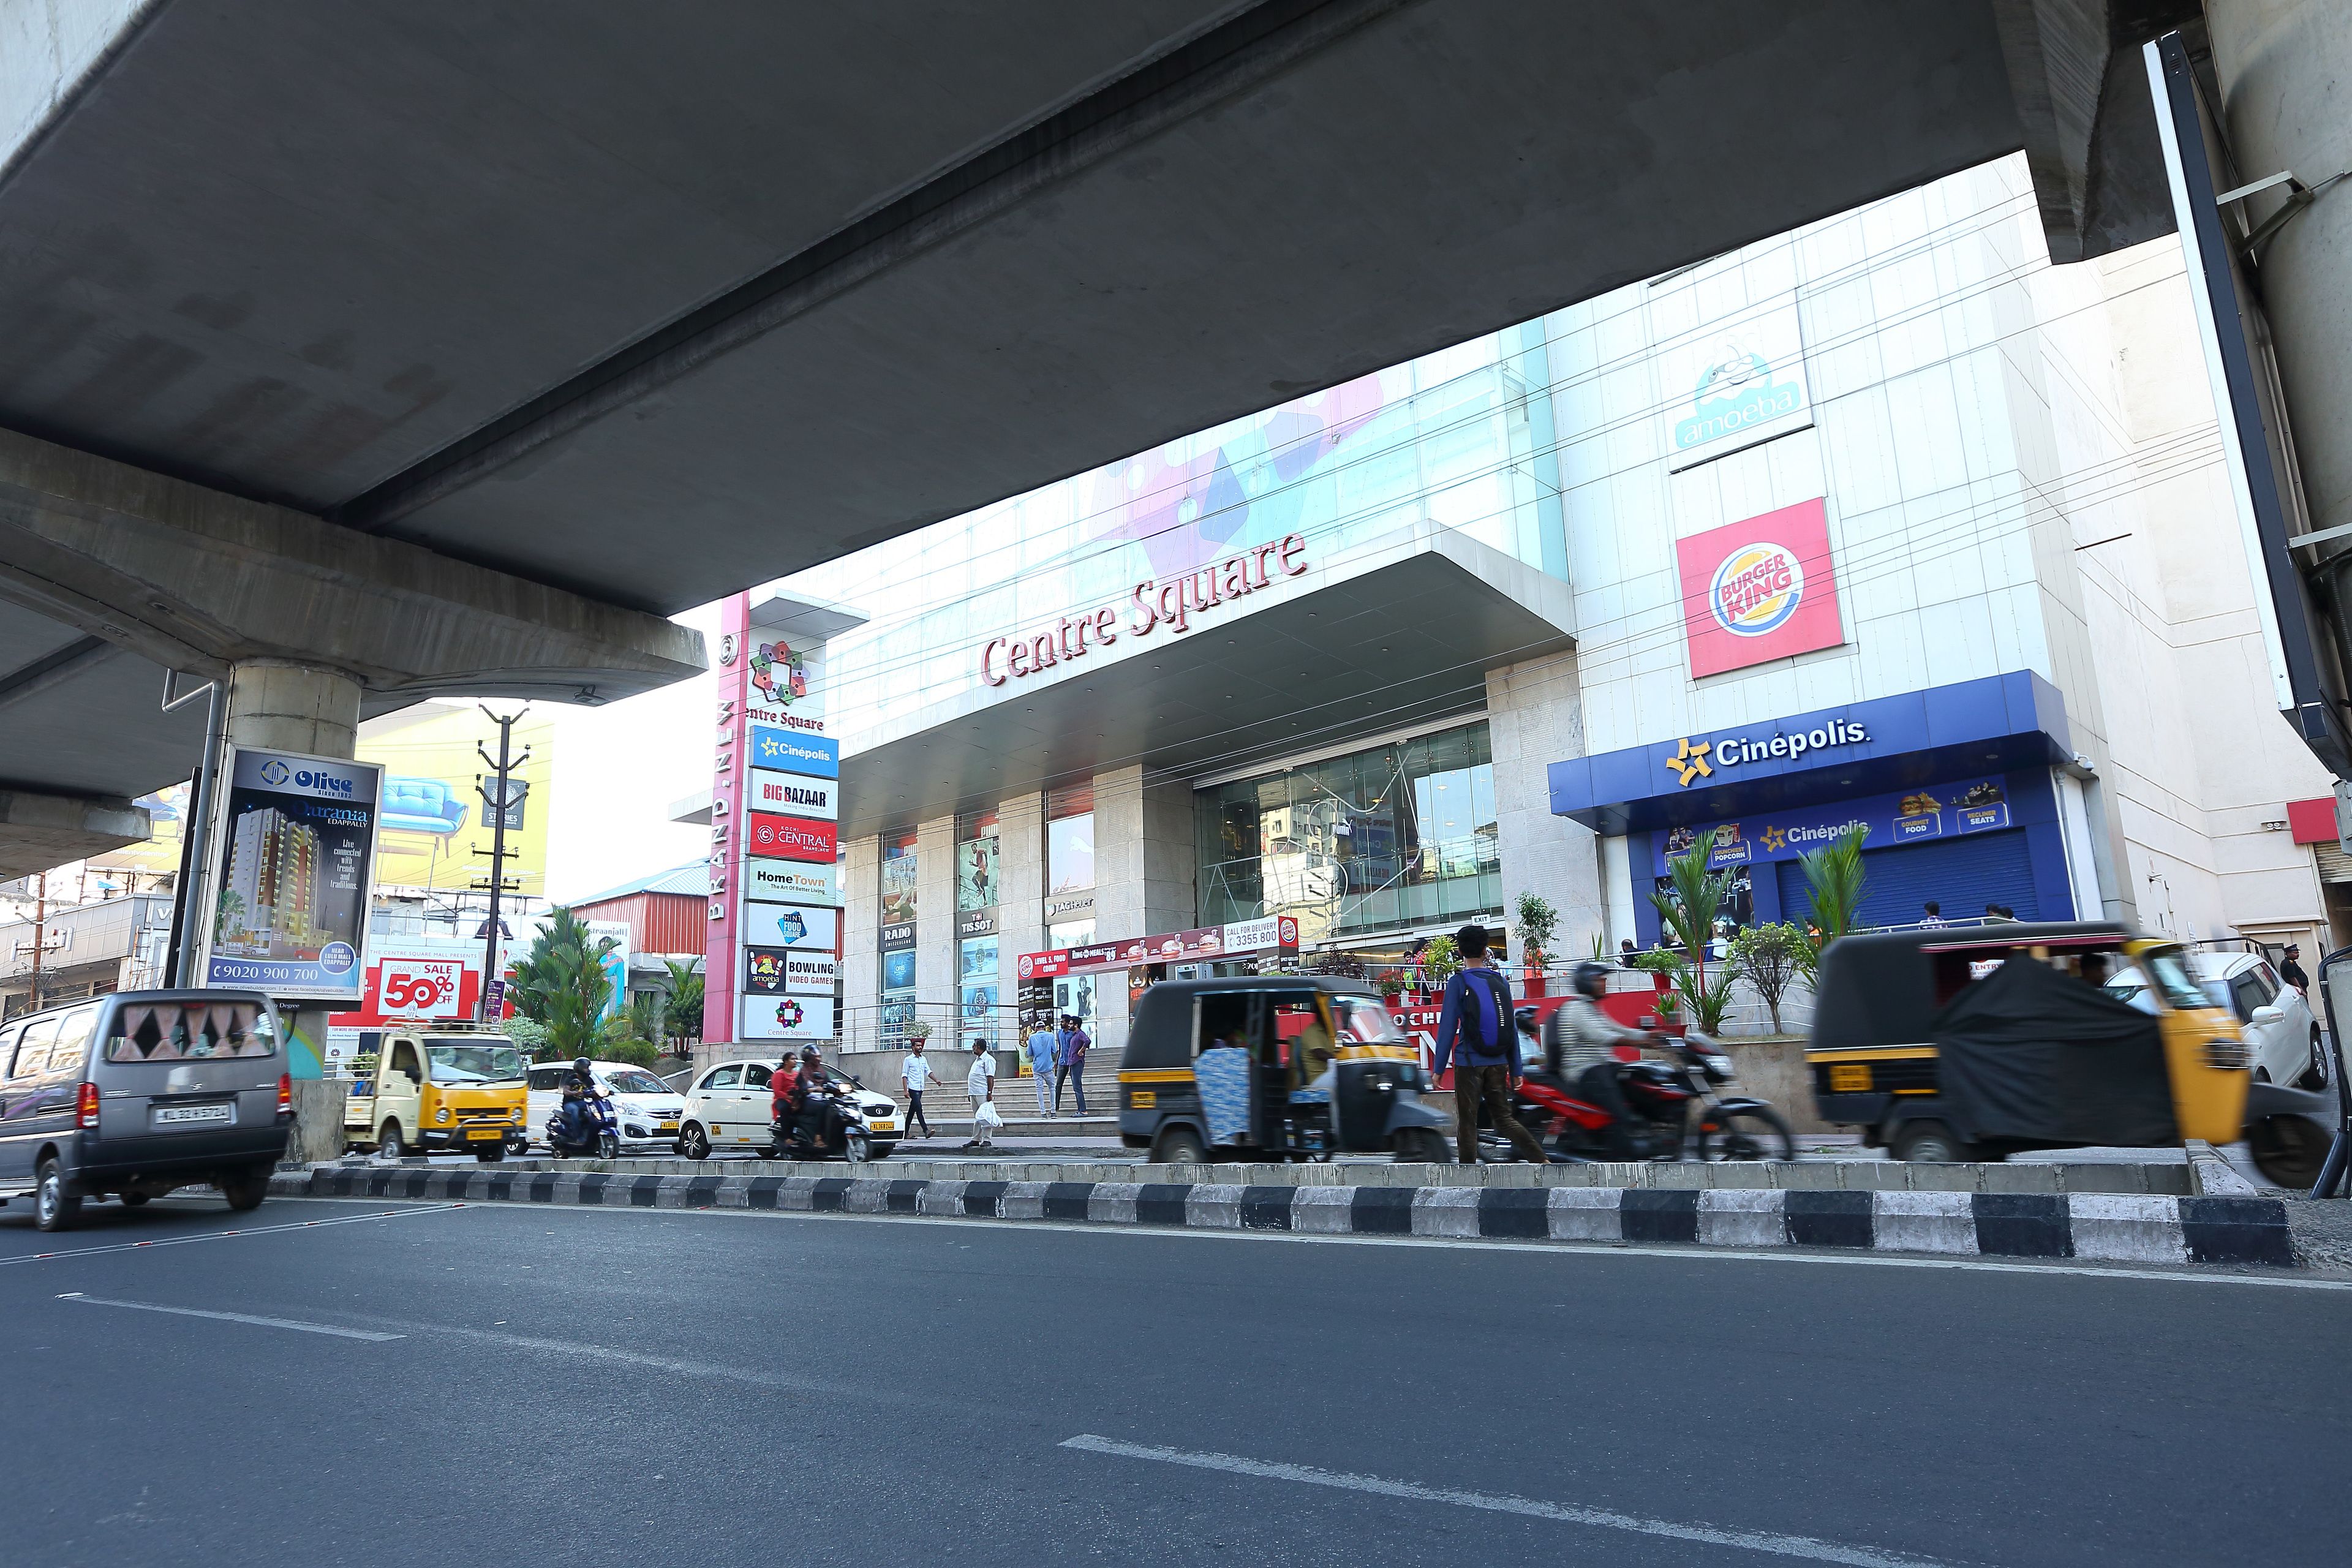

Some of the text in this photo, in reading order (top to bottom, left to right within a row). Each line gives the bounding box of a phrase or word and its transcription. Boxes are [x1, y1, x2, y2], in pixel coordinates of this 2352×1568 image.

[1684, 390, 1793, 444] amoeba
[1721, 554, 1785, 603] BURGER
[1727, 567, 1792, 623] KING
[981, 532, 1307, 687] Centre Square
[780, 712, 824, 731] Square
[294, 771, 353, 793] Olive
[763, 783, 826, 807] BIG BAZAAR
[293, 799, 368, 823] Ourania
[1967, 810, 1996, 819] RECLINER
[488, 812, 518, 822] STRIES
[1970, 816, 1996, 825] SEATS
[328, 818, 368, 828] EDAPPALLY
[1901, 819, 1929, 827] GOURMET
[1332, 824, 1350, 836] PUMA
[1905, 824, 1927, 834] FOOD
[342, 838, 355, 848] Live
[778, 831, 830, 848] CENTRAL
[333, 848, 361, 858] connected
[1714, 846, 1744, 856] CRUNCHIEST
[341, 856, 353, 865] with
[1715, 852, 1745, 861] POPCORN
[336, 864, 355, 873] trends
[757, 870, 825, 887] HomeTown
[330, 880, 358, 890] traditions.
[784, 922, 802, 932] FOOD
[962, 919, 993, 933] TISSOT
[1240, 925, 1251, 934] FOR
[1252, 921, 1276, 932] DELIVERY
[589, 927, 624, 937] straanjali
[884, 927, 911, 941] RADO
[1236, 930, 1276, 946] 3355 800
[1072, 949, 1083, 960] KING
[1090, 948, 1104, 957] MEALS
[1035, 957, 1047, 965] LEVEL
[224, 965, 318, 980] 9020 900 700
[424, 965, 453, 974] SALE
[789, 962, 834, 974] BOWLING
[1020, 963, 1031, 973] KING
[1042, 964, 1058, 973] COURT
[789, 975, 834, 985] VIDEO GAMES
[436, 995, 453, 1004] OFF
[1393, 1012, 1442, 1027] OCHI
